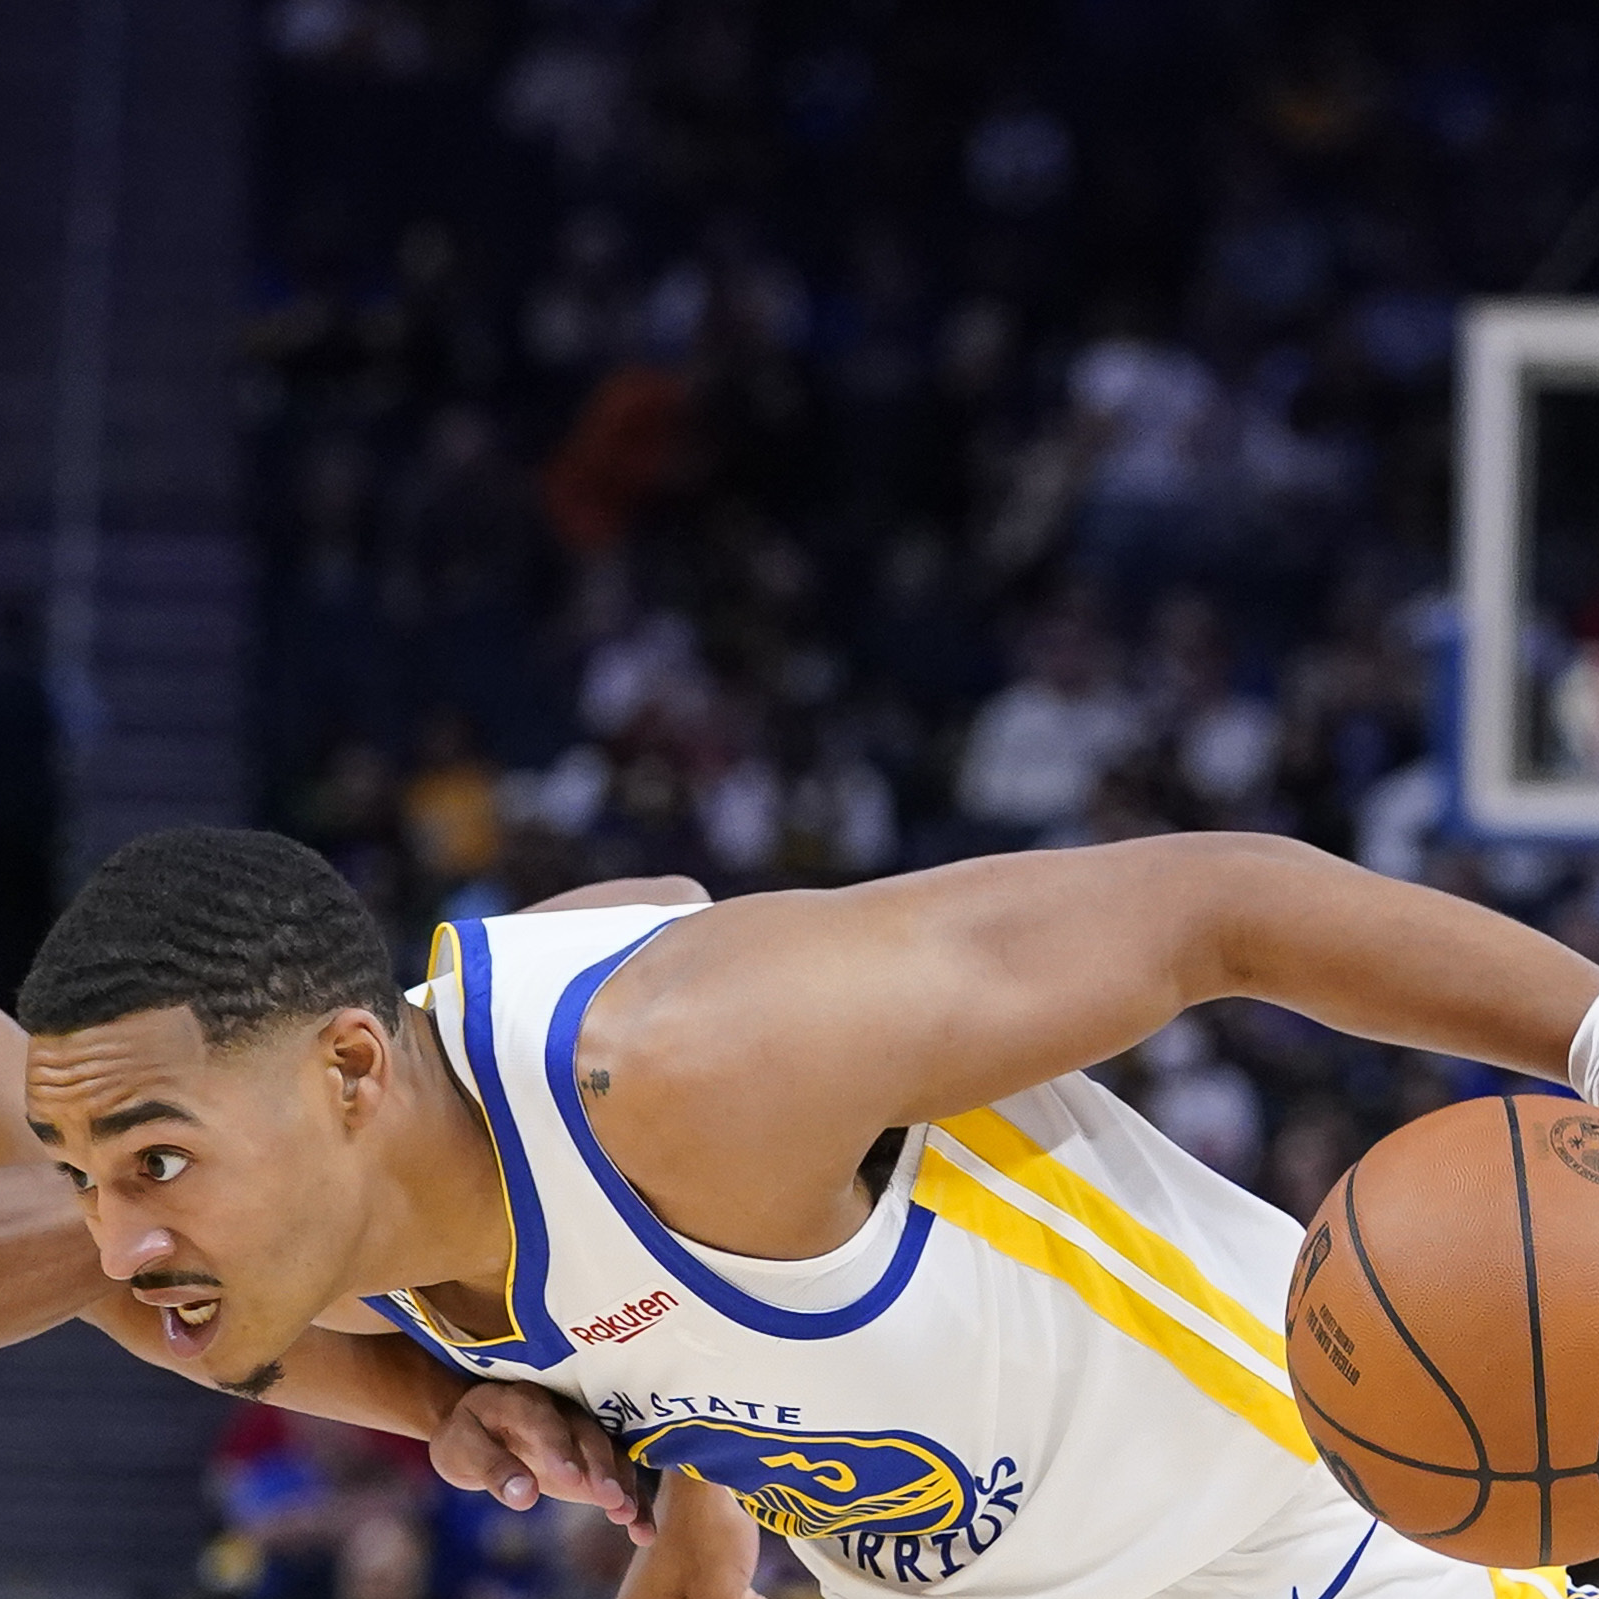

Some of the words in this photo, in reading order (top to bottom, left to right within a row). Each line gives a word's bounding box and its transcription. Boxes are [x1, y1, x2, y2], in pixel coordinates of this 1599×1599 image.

[569, 1290, 679, 1345] Rakuten
[650, 1391, 802, 1425] STATE
[838, 1456, 1023, 1583] RRIORS
